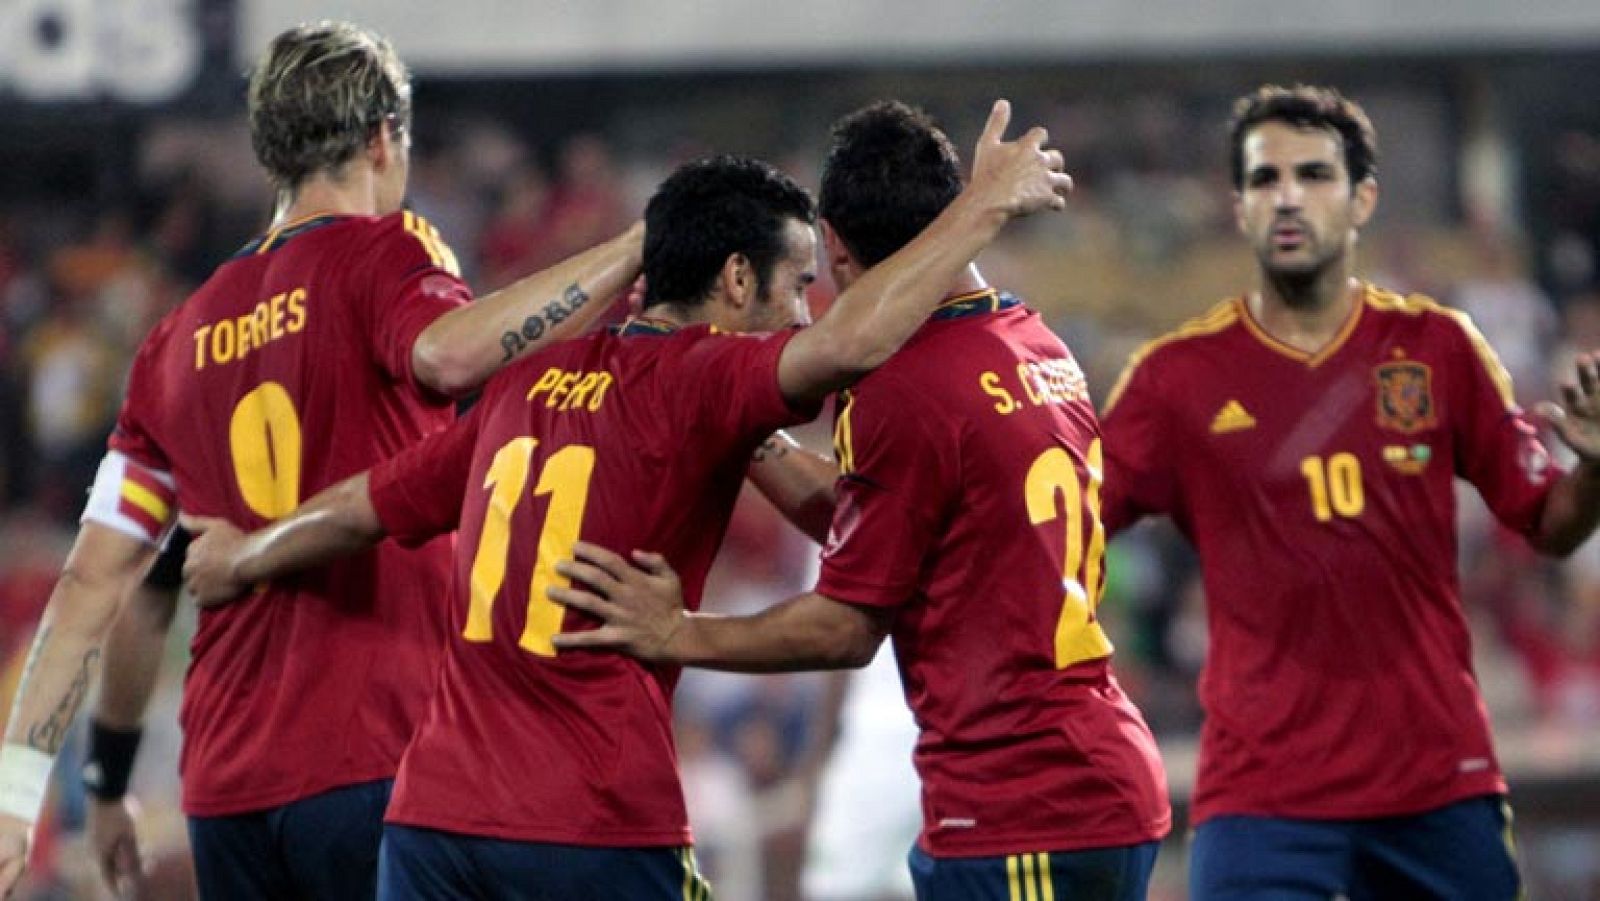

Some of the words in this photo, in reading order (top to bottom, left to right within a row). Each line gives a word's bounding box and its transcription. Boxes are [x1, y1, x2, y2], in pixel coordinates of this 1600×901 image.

[193, 287, 307, 369] TORRES
[526, 367, 613, 412] PERO
[1301, 452, 1365, 522] 10
[463, 436, 596, 657] 11
